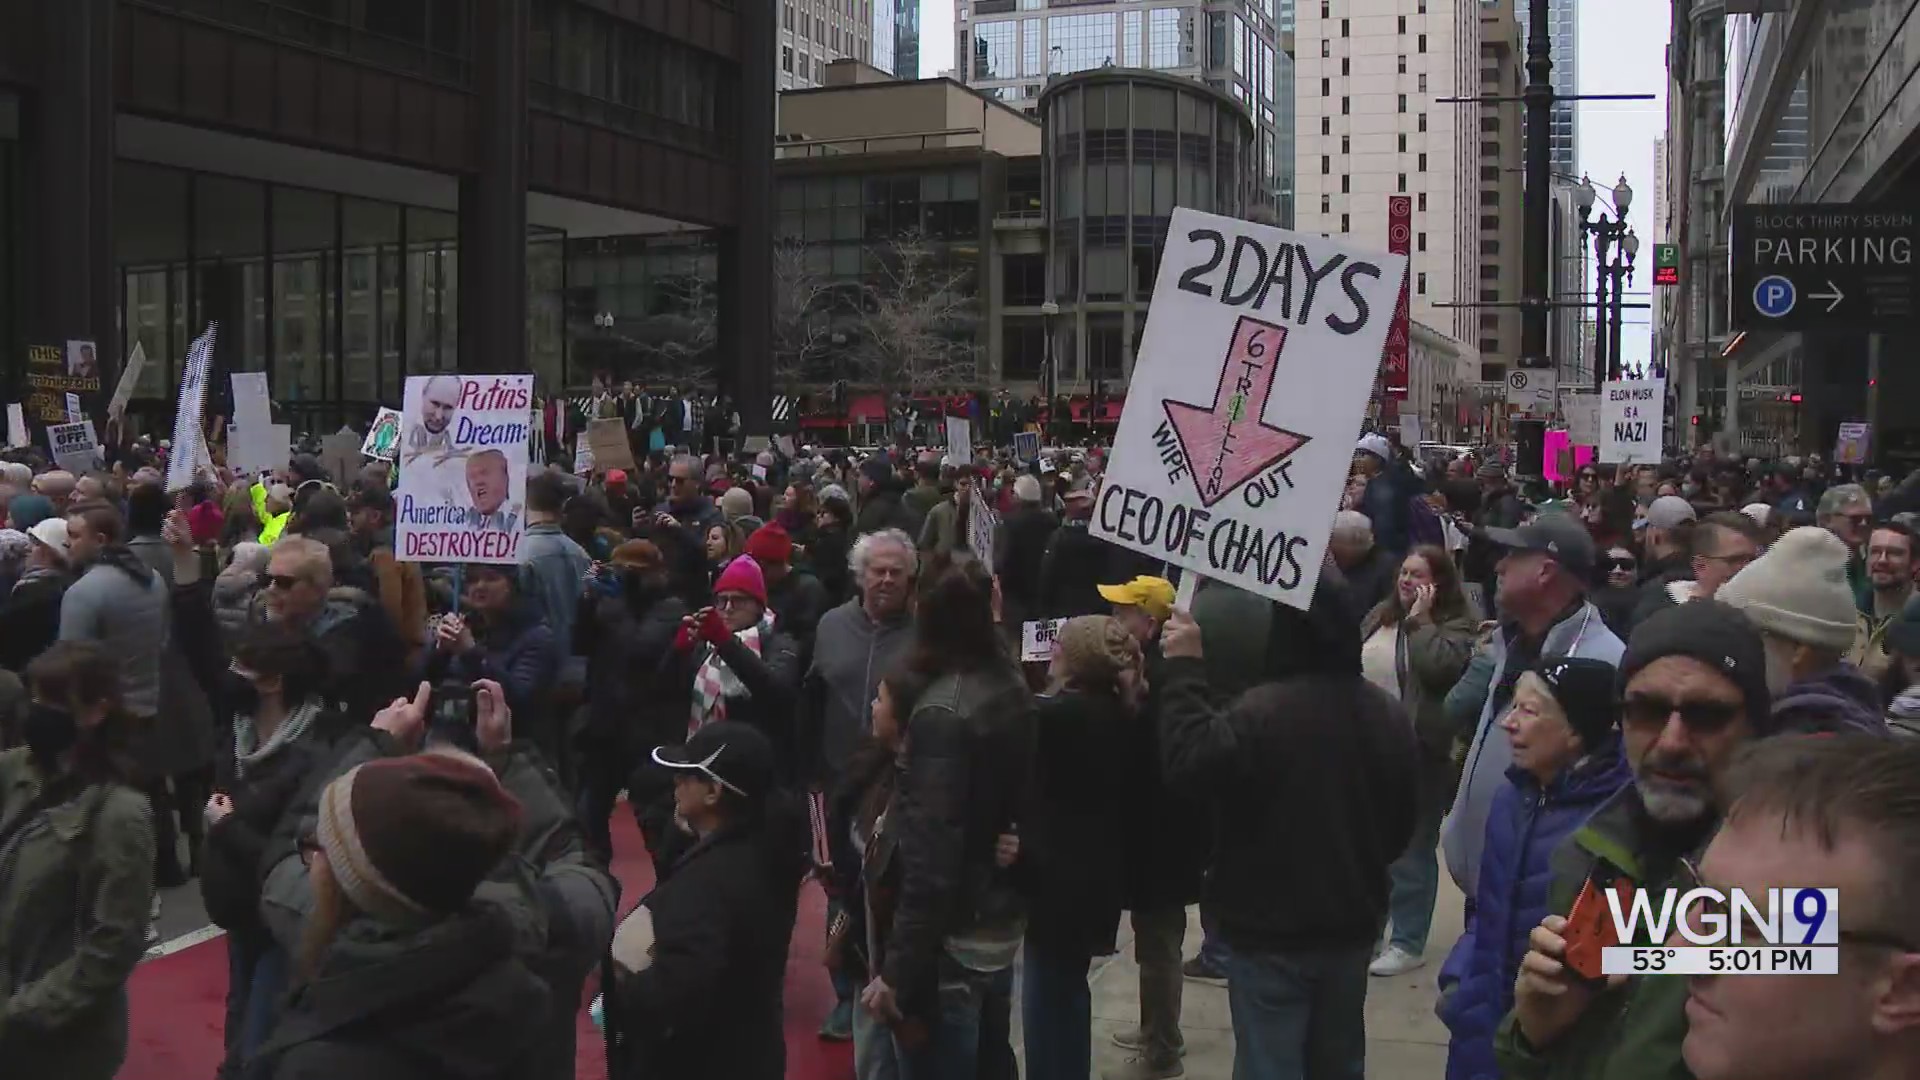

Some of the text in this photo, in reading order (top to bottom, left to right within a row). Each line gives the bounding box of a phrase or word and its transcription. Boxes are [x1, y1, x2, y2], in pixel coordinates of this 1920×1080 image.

[1755, 214, 1912, 229] BLOCK THIRTY SEVEN
[1754, 237, 1912, 265] PARKING
[1767, 285, 1785, 308] P
[1247, 329, 1266, 358] 6
[458, 378, 528, 411] Putin's
[1610, 388, 1654, 401] ELON MUSK
[1623, 405, 1639, 418] IS A
[56, 431, 88, 445] OFF!
[455, 416, 528, 445] Dream:
[1613, 421, 1648, 442] NAZI
[1151, 420, 1189, 485] WIPE
[1243, 459, 1294, 509] OUT
[400, 494, 466, 525] America
[406, 531, 520, 558] DESTROYED!
[1099, 484, 1309, 591] CEO OF CHAOS
